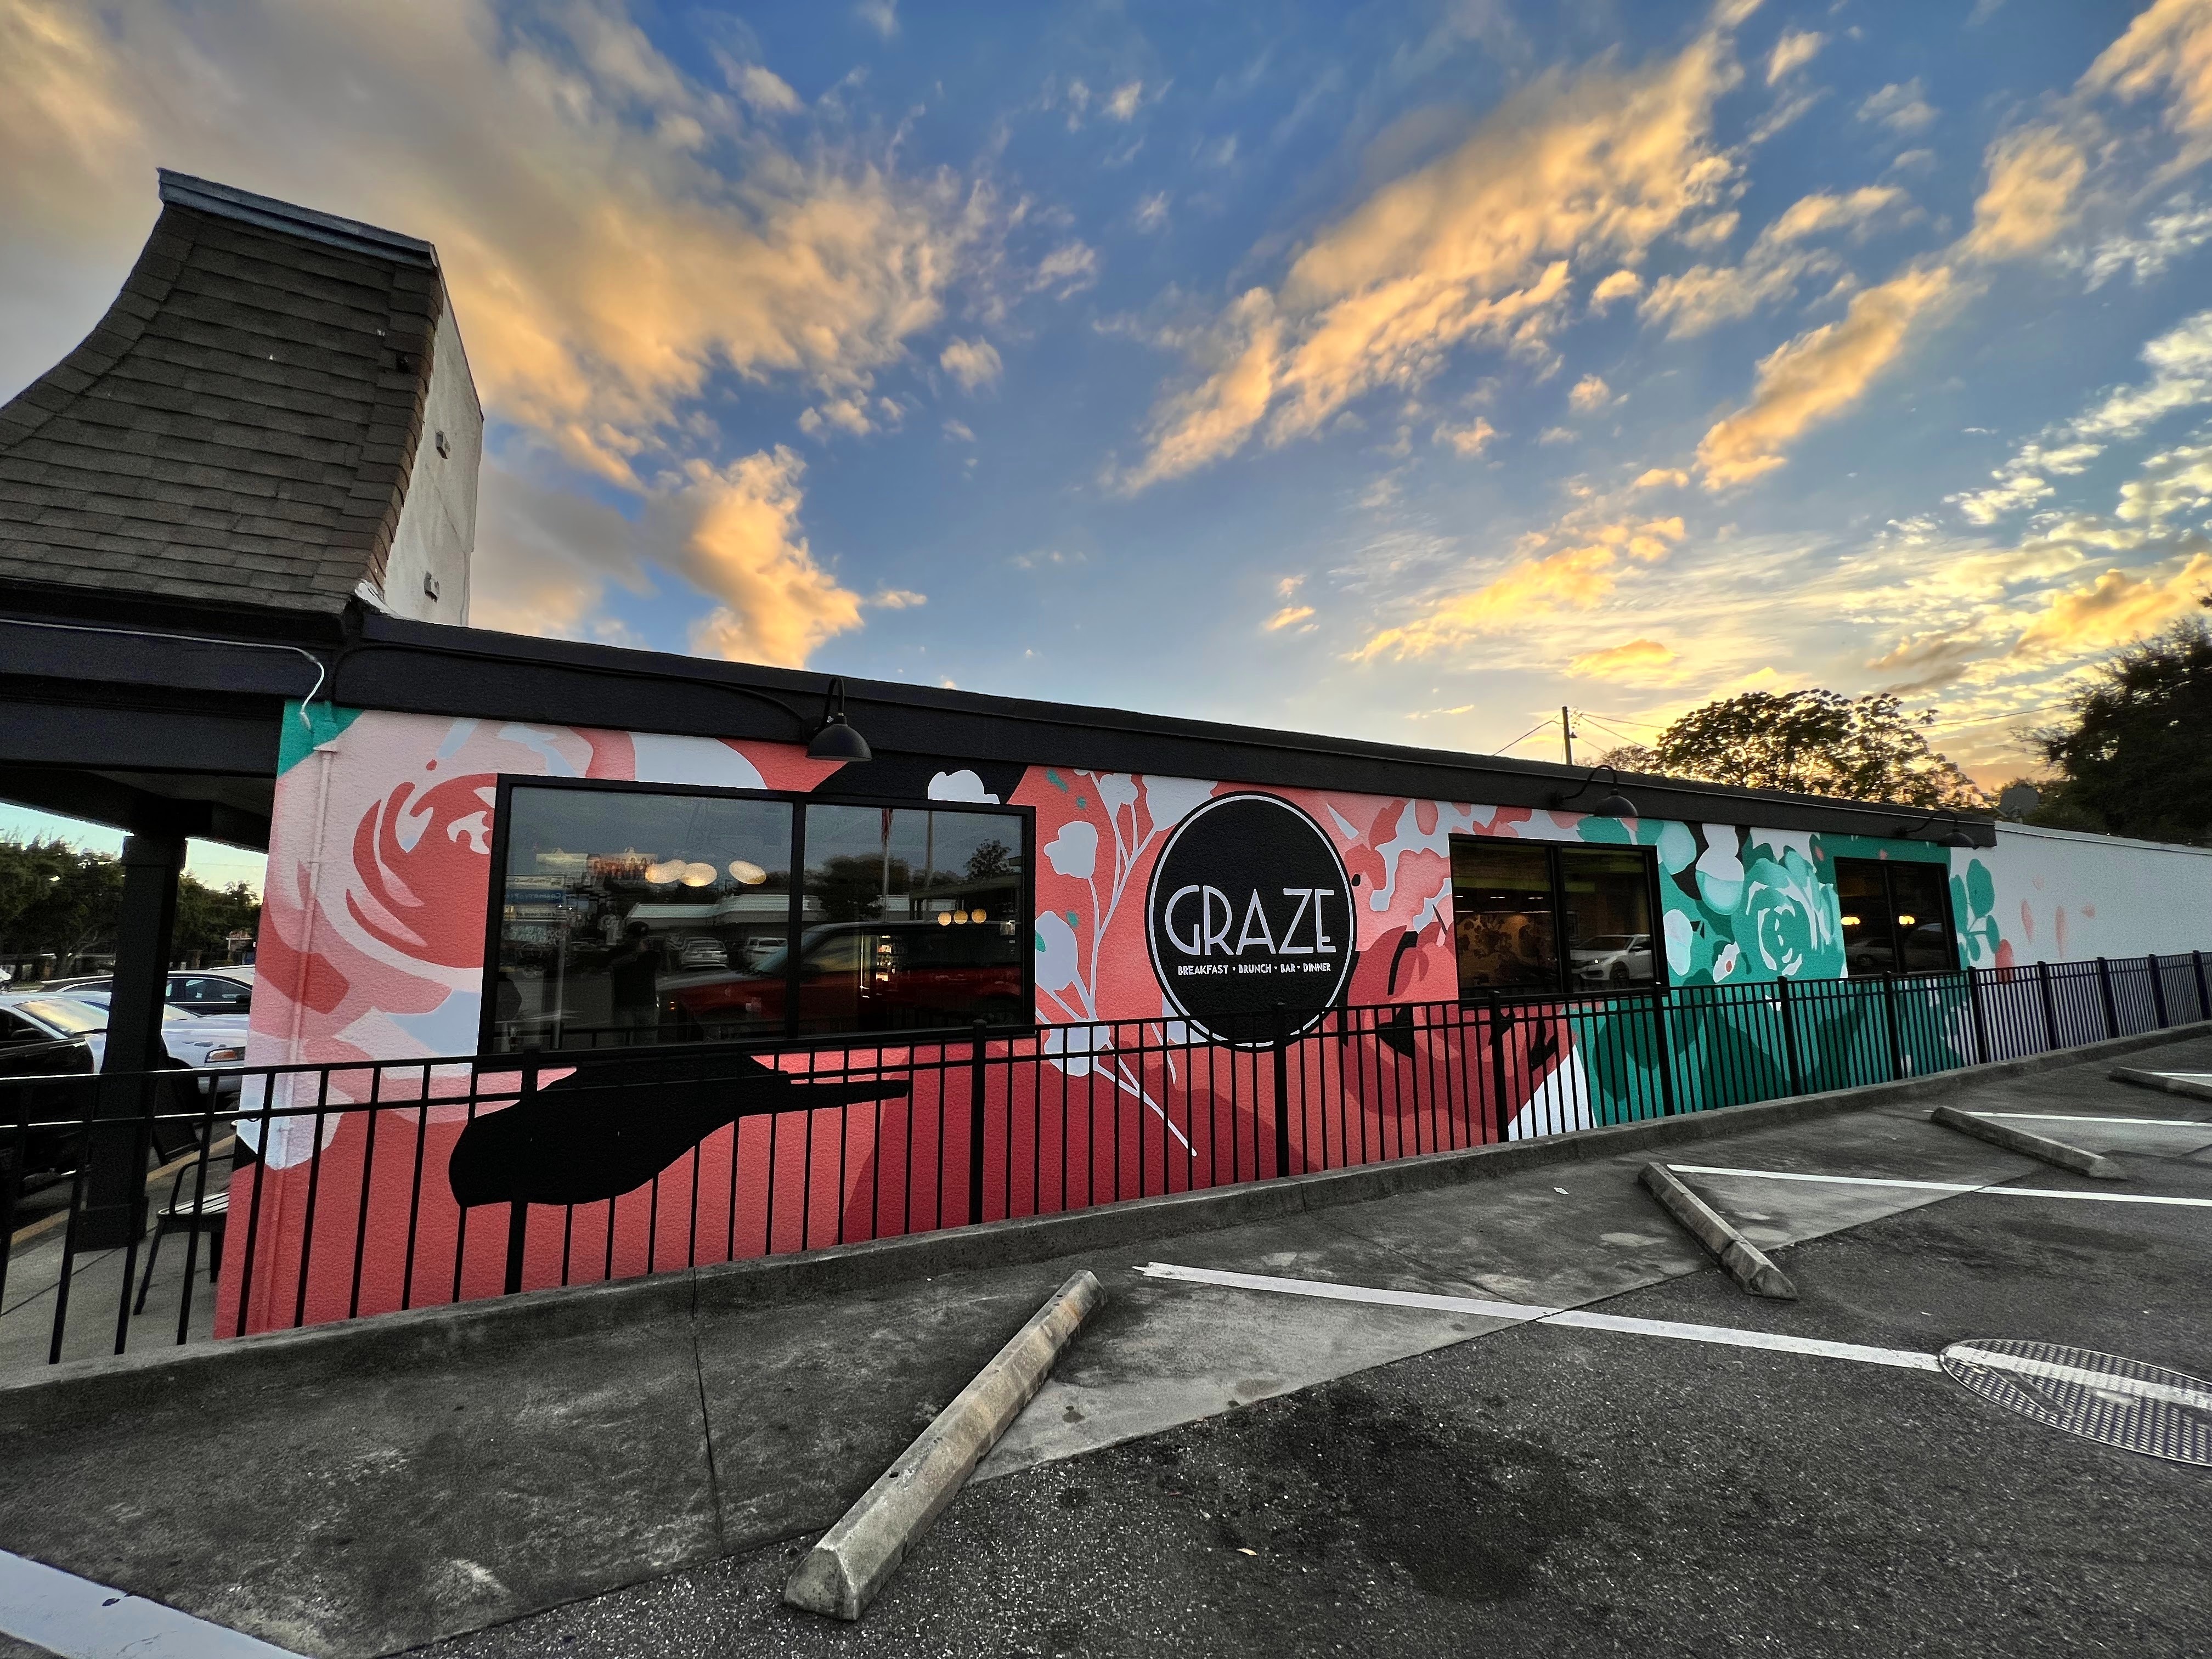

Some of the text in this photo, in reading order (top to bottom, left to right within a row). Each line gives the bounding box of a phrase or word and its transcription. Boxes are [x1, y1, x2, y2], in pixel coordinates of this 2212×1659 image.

[1165, 884, 1336, 956] GRAZE
[1178, 962, 1331, 975] BREAKFAST BRUNCH BAR DINNER
